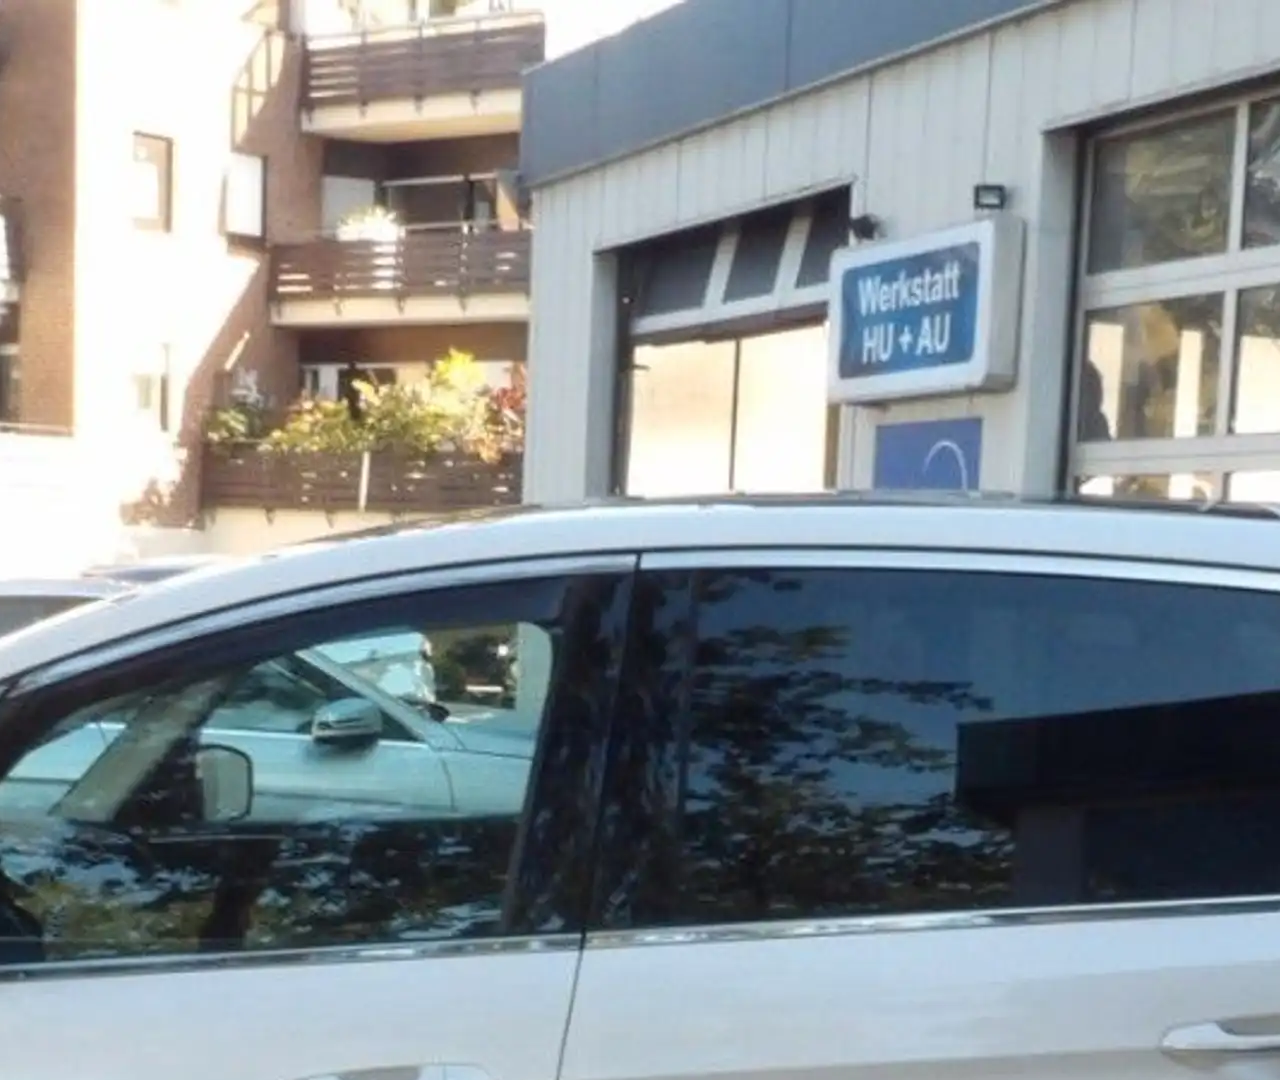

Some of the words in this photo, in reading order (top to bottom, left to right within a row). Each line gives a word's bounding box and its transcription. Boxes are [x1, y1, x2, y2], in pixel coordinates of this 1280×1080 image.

[858, 260, 960, 317] Werkstatt
[862, 322, 895, 364] HU
[899, 324, 913, 354] +
[915, 312, 952, 356] AU
